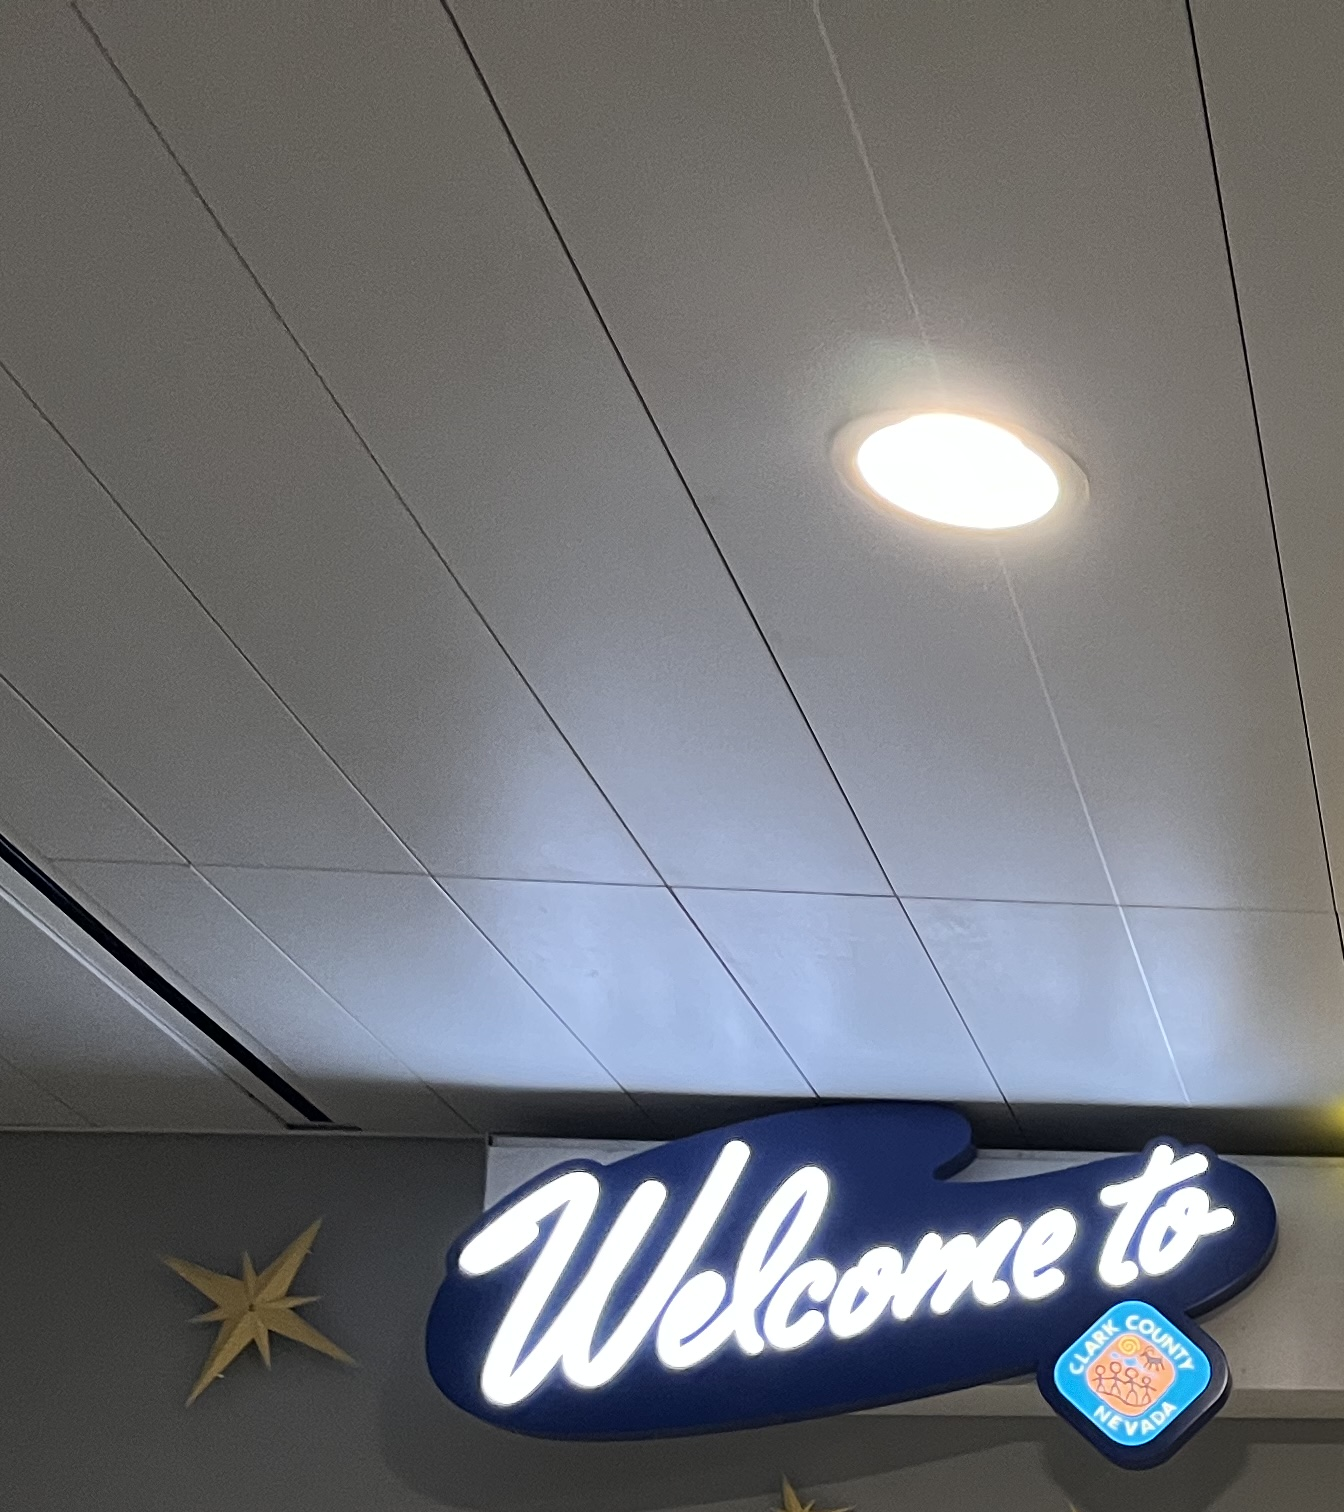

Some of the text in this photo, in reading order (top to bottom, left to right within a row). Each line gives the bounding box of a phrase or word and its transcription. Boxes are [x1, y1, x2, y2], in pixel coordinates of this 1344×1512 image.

[458, 1140, 1235, 1406] Welcome to
[1069, 1315, 1195, 1375] CLARK COUNTY
[1093, 1401, 1178, 1437] NEVADA
